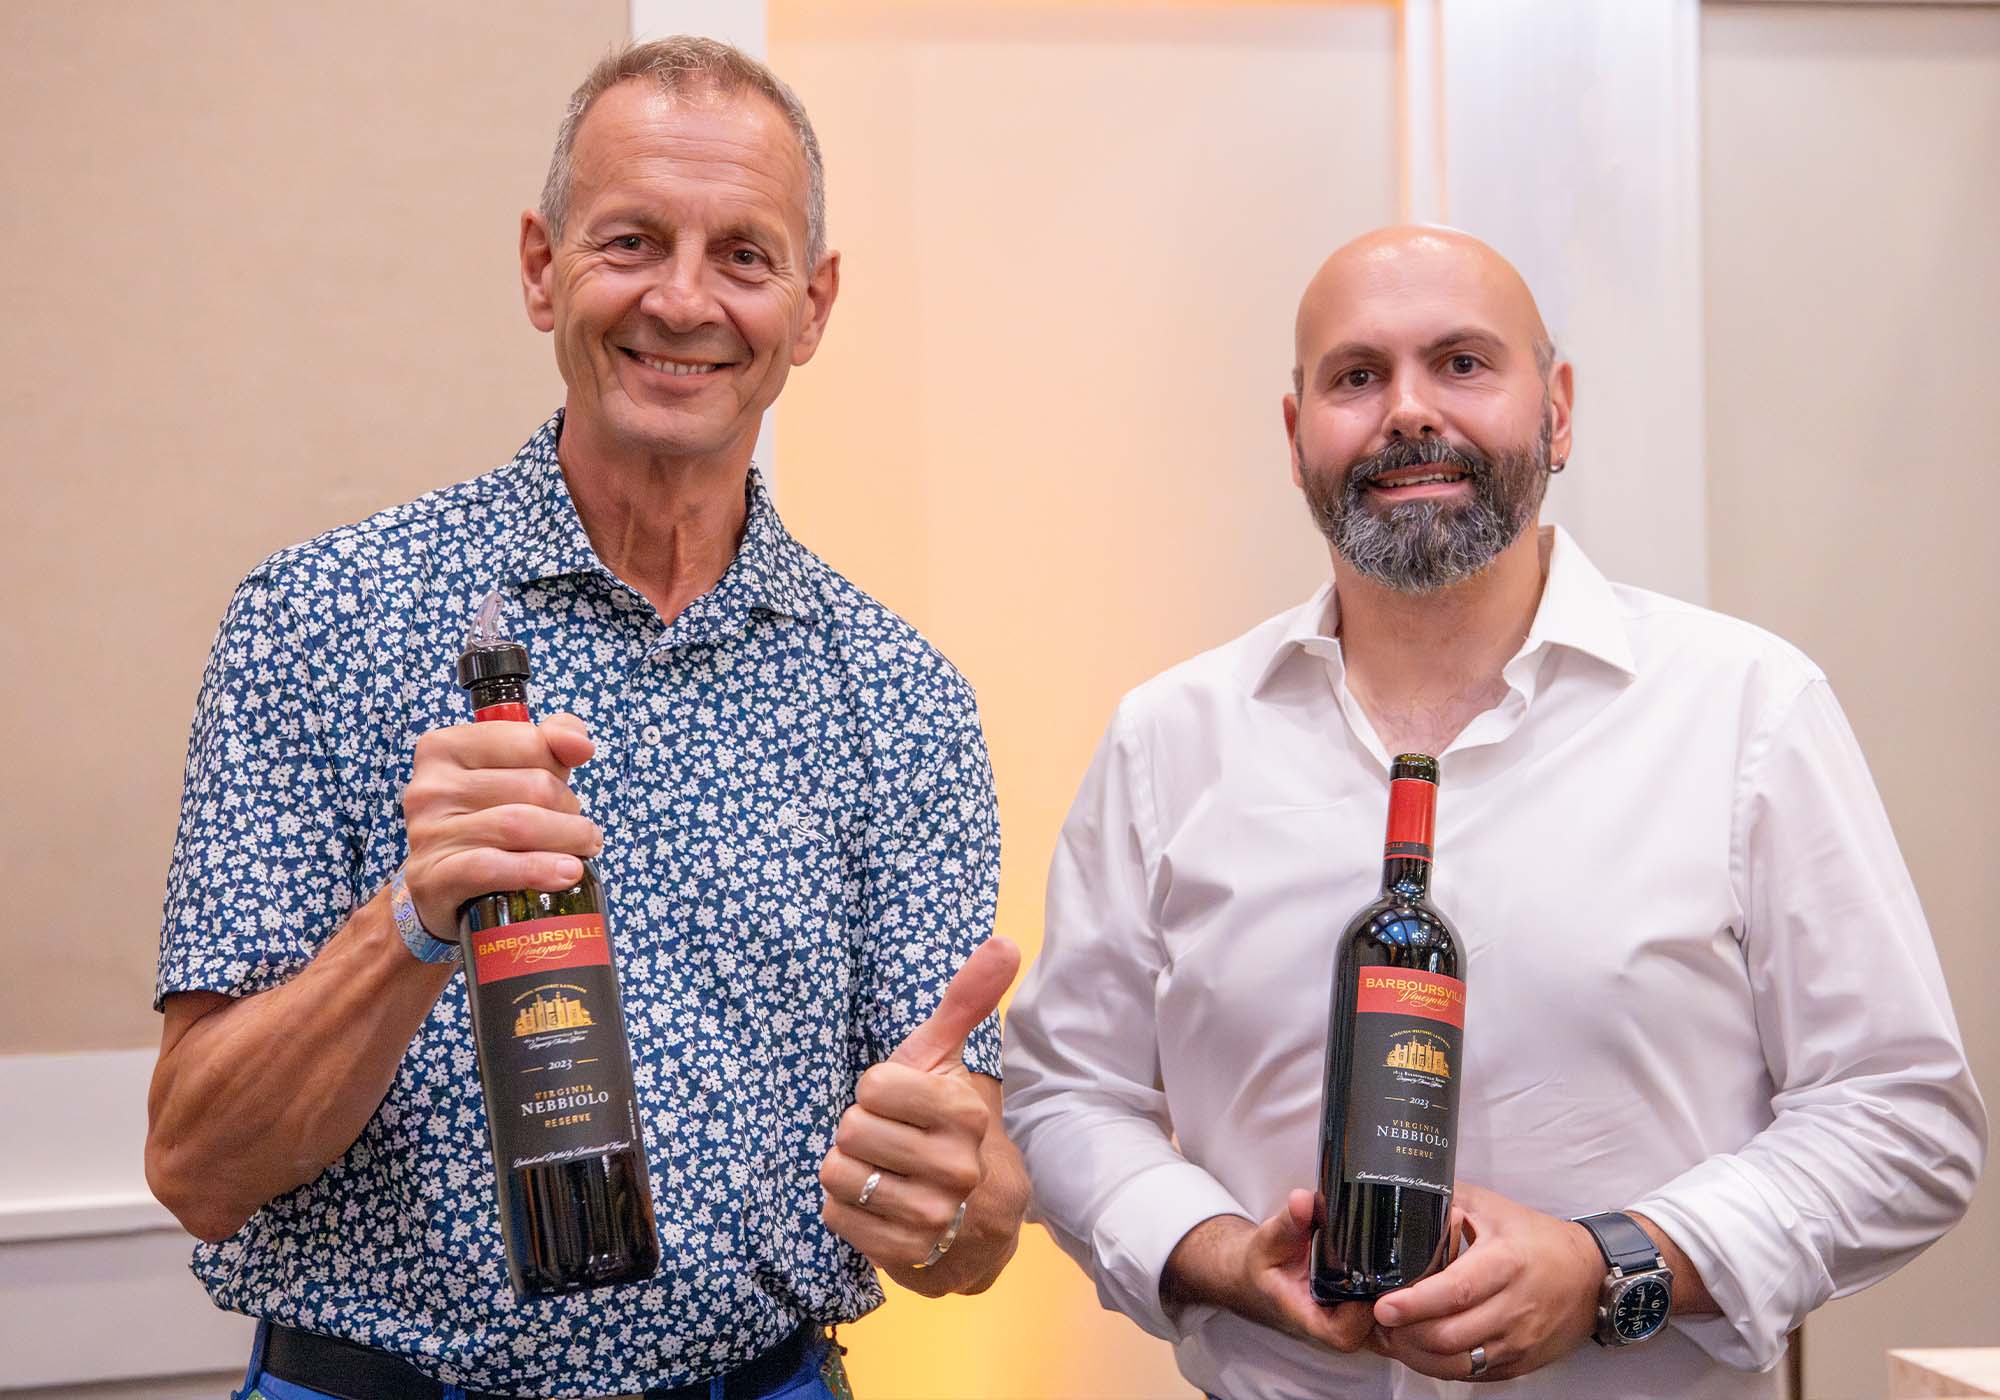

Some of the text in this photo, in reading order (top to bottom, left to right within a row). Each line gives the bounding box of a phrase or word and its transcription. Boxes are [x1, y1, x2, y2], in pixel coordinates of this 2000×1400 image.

[479, 926, 603, 956] BARBOURSVILLE
[511, 941, 577, 964] Vineyards
[1366, 978, 1465, 1005] BARBOURSVILL
[1396, 990, 1449, 1012] Vineyards
[548, 1059, 573, 1071] 2023
[534, 1084, 594, 1101] VIRGINIA
[521, 1091, 609, 1117] NEBBIOLO
[1409, 1097, 1430, 1110] 2023
[544, 1112, 592, 1129] RESERVE
[1392, 1119, 1440, 1135] VIRGINIA
[1376, 1125, 1449, 1148] NEBBIOLO
[1395, 1145, 1434, 1159] RESERVE
